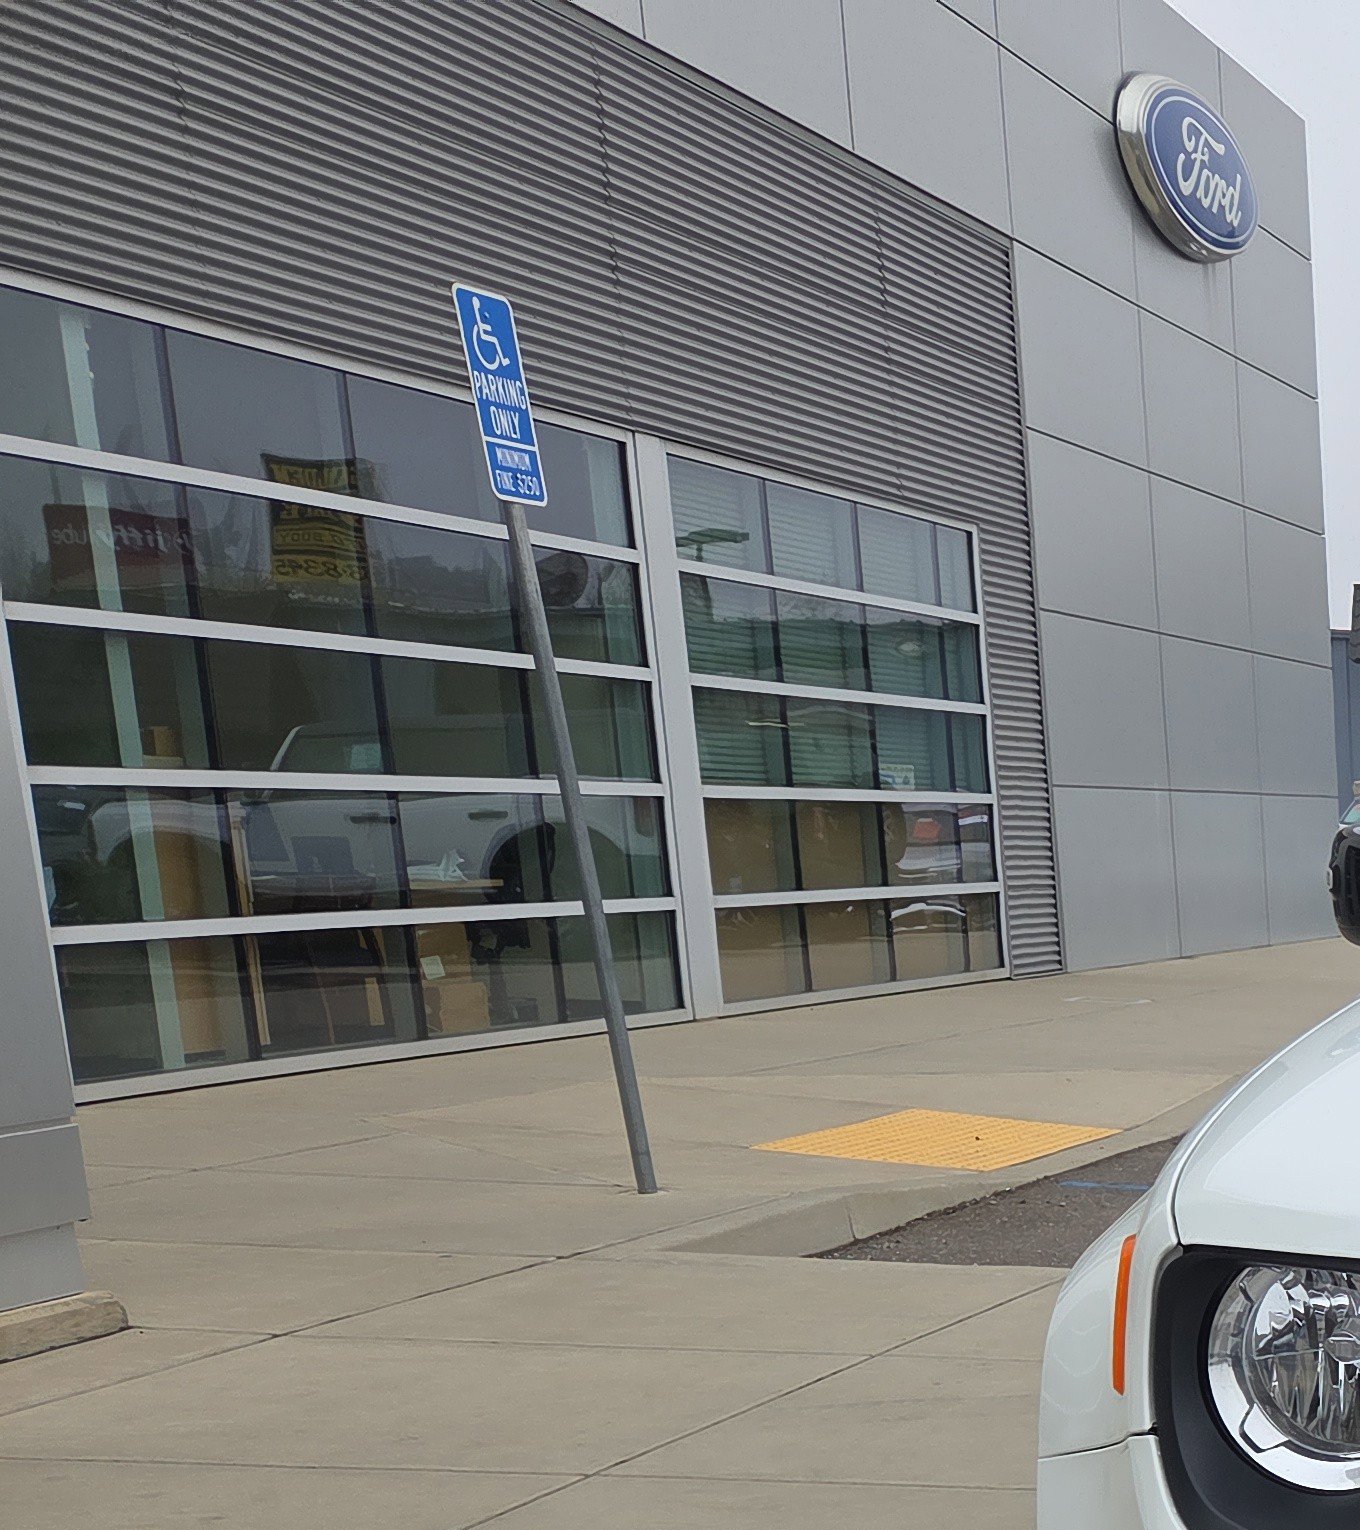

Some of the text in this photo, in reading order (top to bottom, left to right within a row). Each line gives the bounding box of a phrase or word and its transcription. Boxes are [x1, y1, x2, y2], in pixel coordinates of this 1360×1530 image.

[1176, 116, 1242, 227] Ford
[473, 370, 527, 410] PARKING
[489, 406, 521, 439] ONLY
[516, 472, 540, 496] $250
